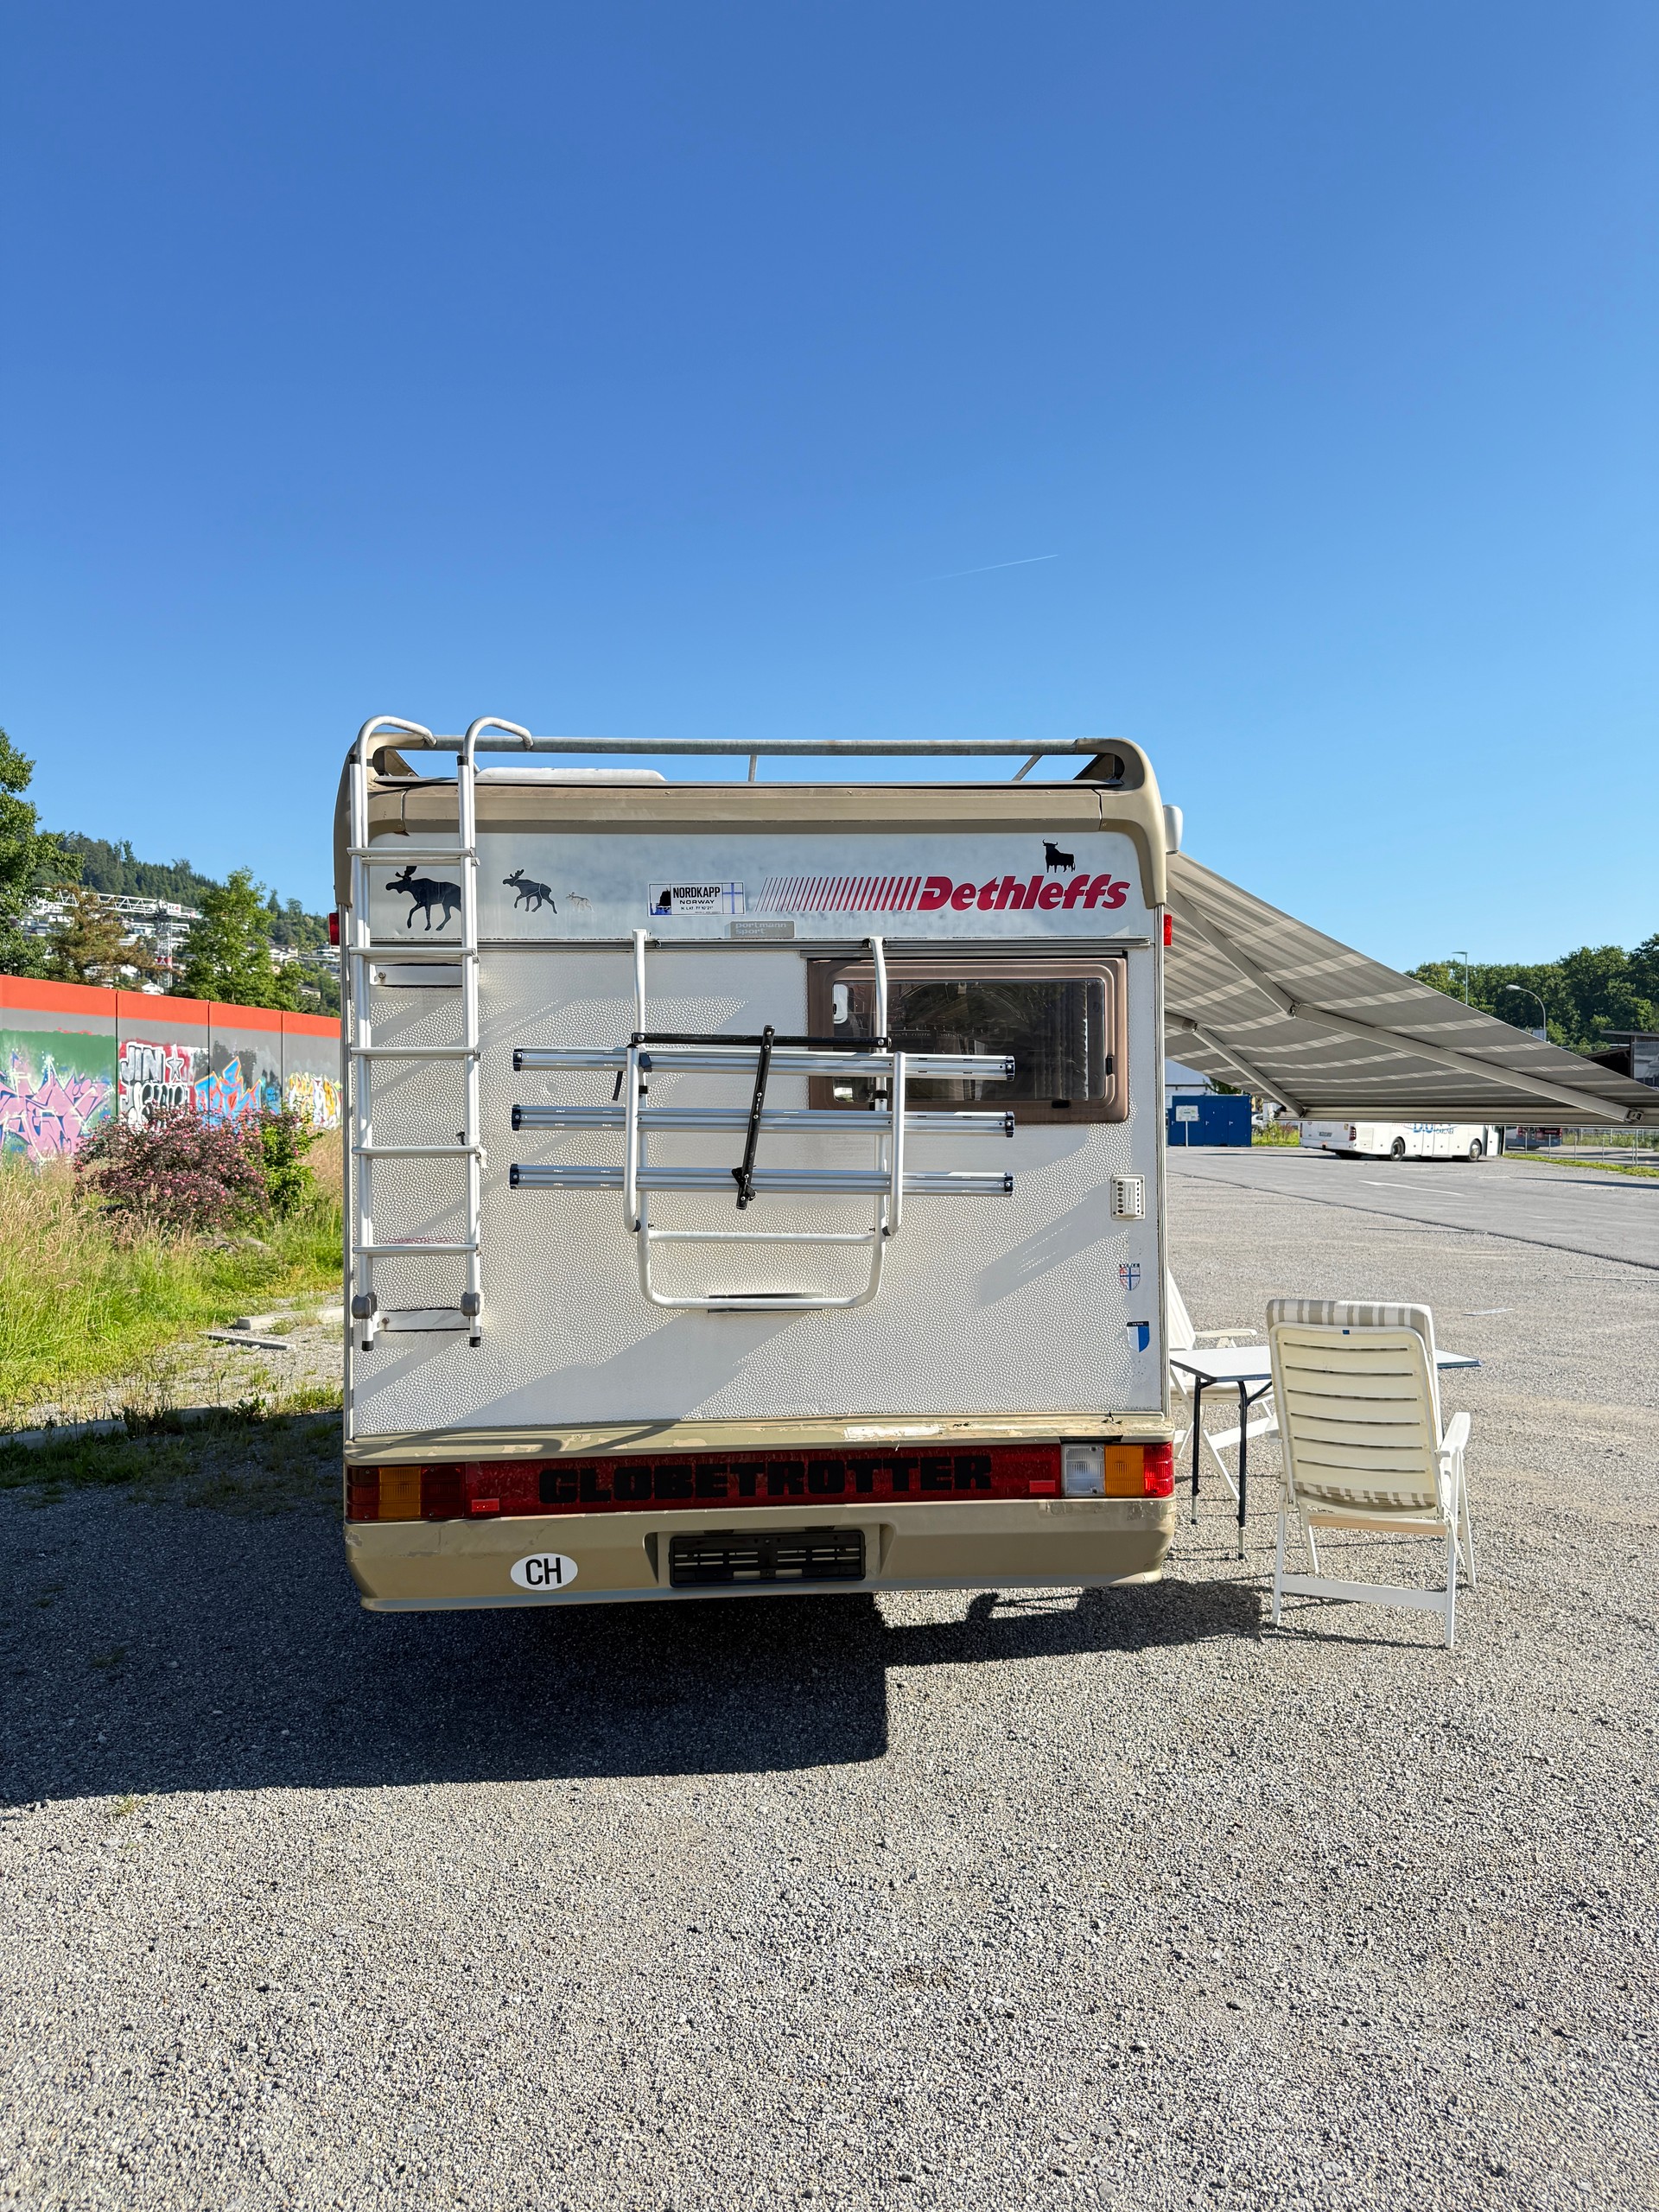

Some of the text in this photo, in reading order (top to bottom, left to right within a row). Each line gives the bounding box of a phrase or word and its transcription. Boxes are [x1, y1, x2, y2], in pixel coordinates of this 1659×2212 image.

[672, 887, 721, 899] NORDKAPP
[918, 874, 1131, 911] Dethleffs
[539, 1455, 993, 1504] GLOBETROTTER
[525, 1557, 563, 1586] CH
